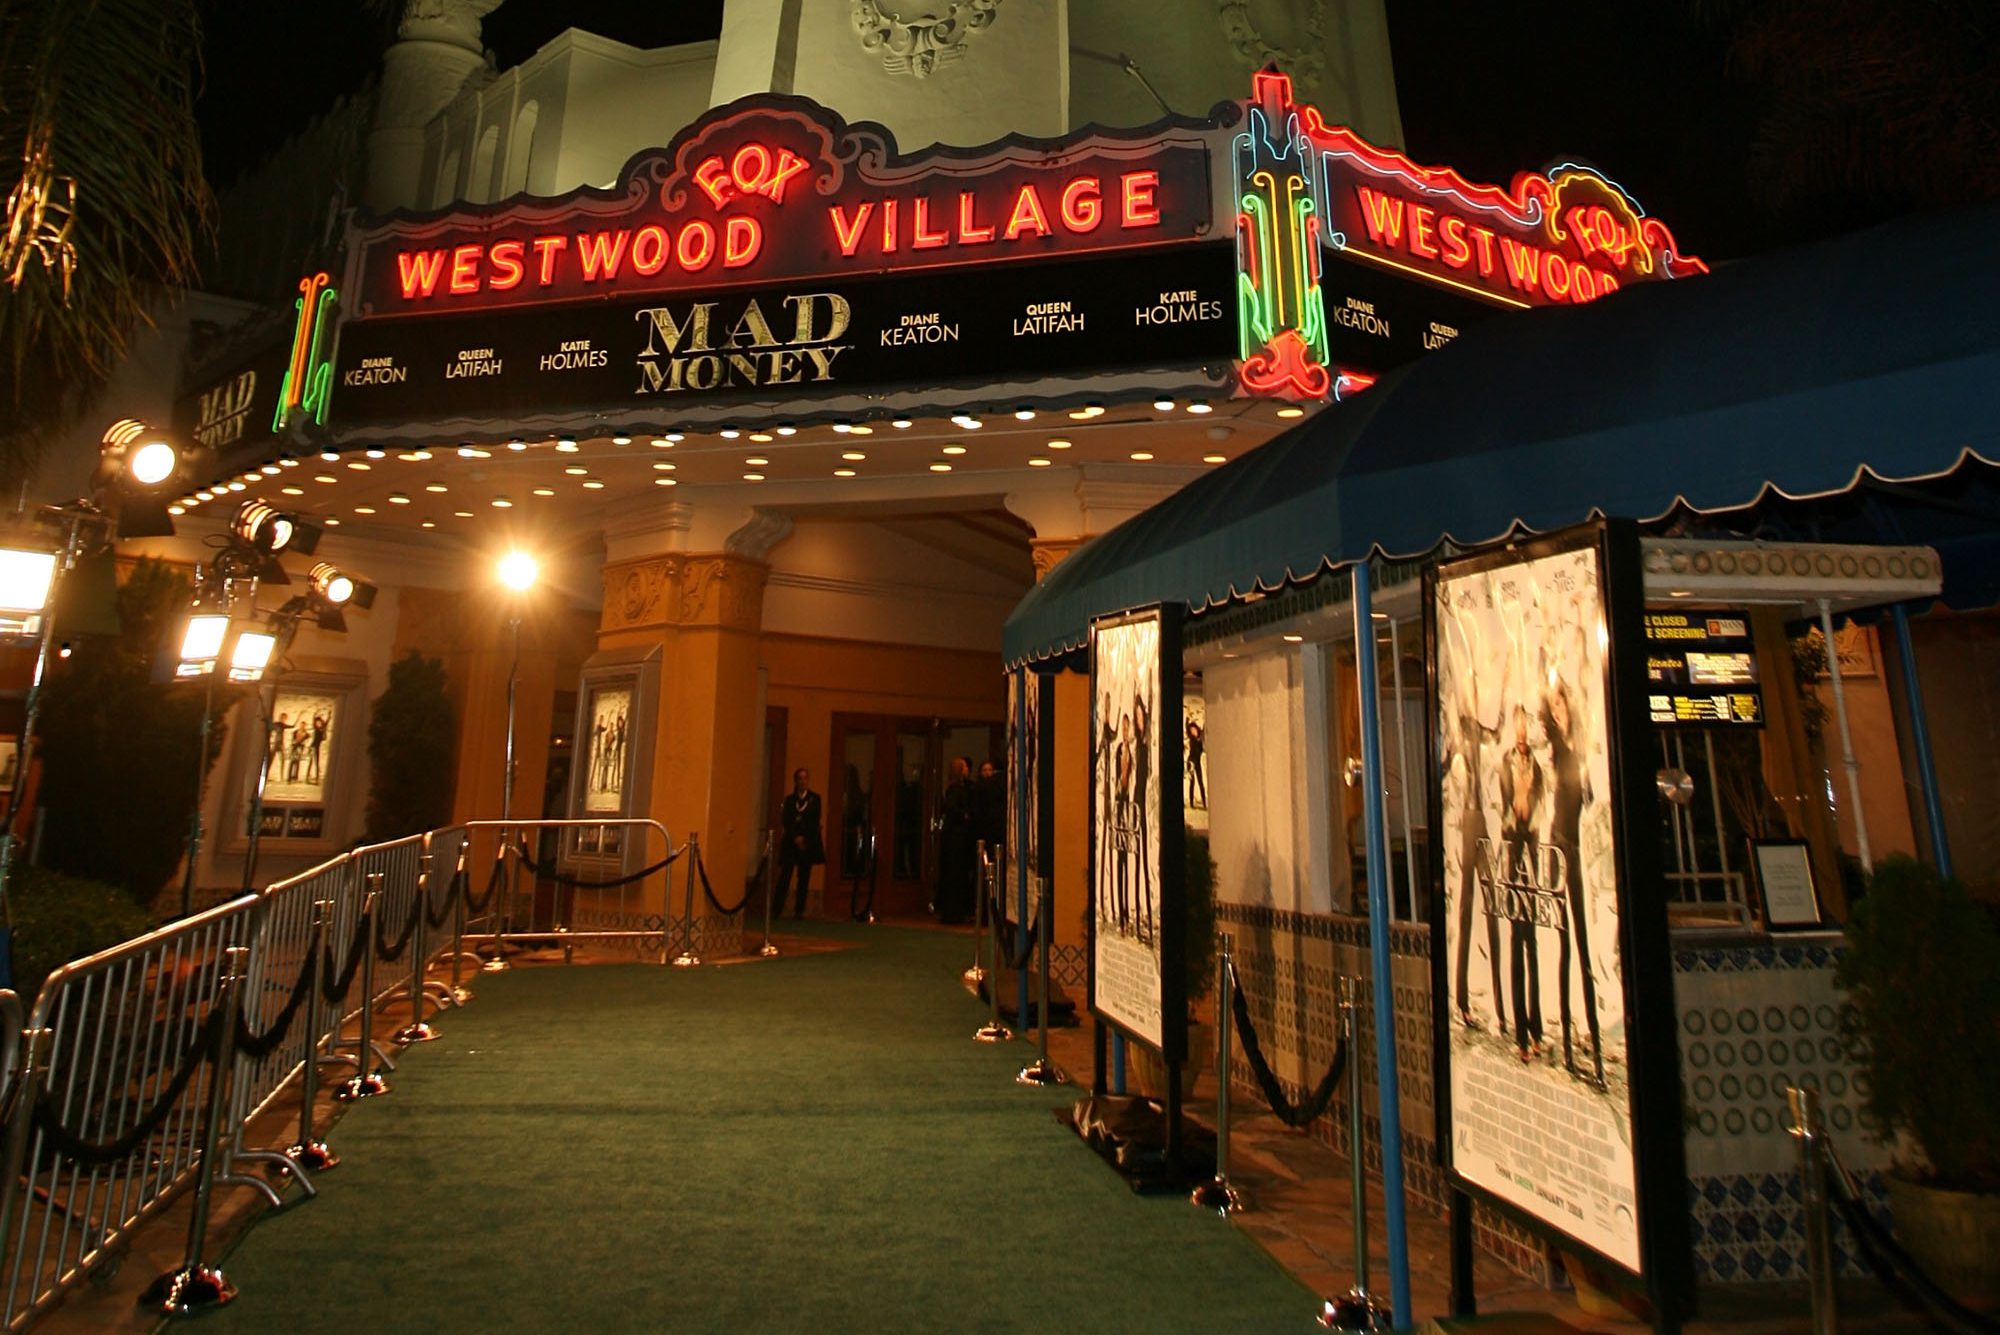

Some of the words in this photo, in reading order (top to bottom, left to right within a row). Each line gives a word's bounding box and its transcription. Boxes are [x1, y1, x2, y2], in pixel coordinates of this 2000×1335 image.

[694, 141, 811, 212] FOX
[397, 214, 762, 299] WESTWOOD
[829, 170, 1160, 256] VILLAGE
[1565, 206, 1634, 268] FOX
[1160, 290, 1197, 303] KATIE
[1347, 297, 1374, 315] DIANE
[1026, 301, 1071, 315] QUEEN
[1136, 301, 1222, 326] HOLMES
[635, 293, 850, 357] MAD
[901, 313, 940, 326] DIANE
[1013, 313, 1085, 336] LATIFAH
[1333, 306, 1389, 338] KEATON
[560, 340, 591, 352] KATIE
[880, 324, 959, 347] KEATON
[361, 356, 393, 368] DIANE
[458, 348, 494, 361] QUEEN
[540, 350, 608, 371] HOLMES
[344, 366, 406, 386] KEATON
[446, 358, 502, 379] LATIFAH
[635, 346, 842, 394] MONEY
[1476, 838, 1567, 896] MAD
